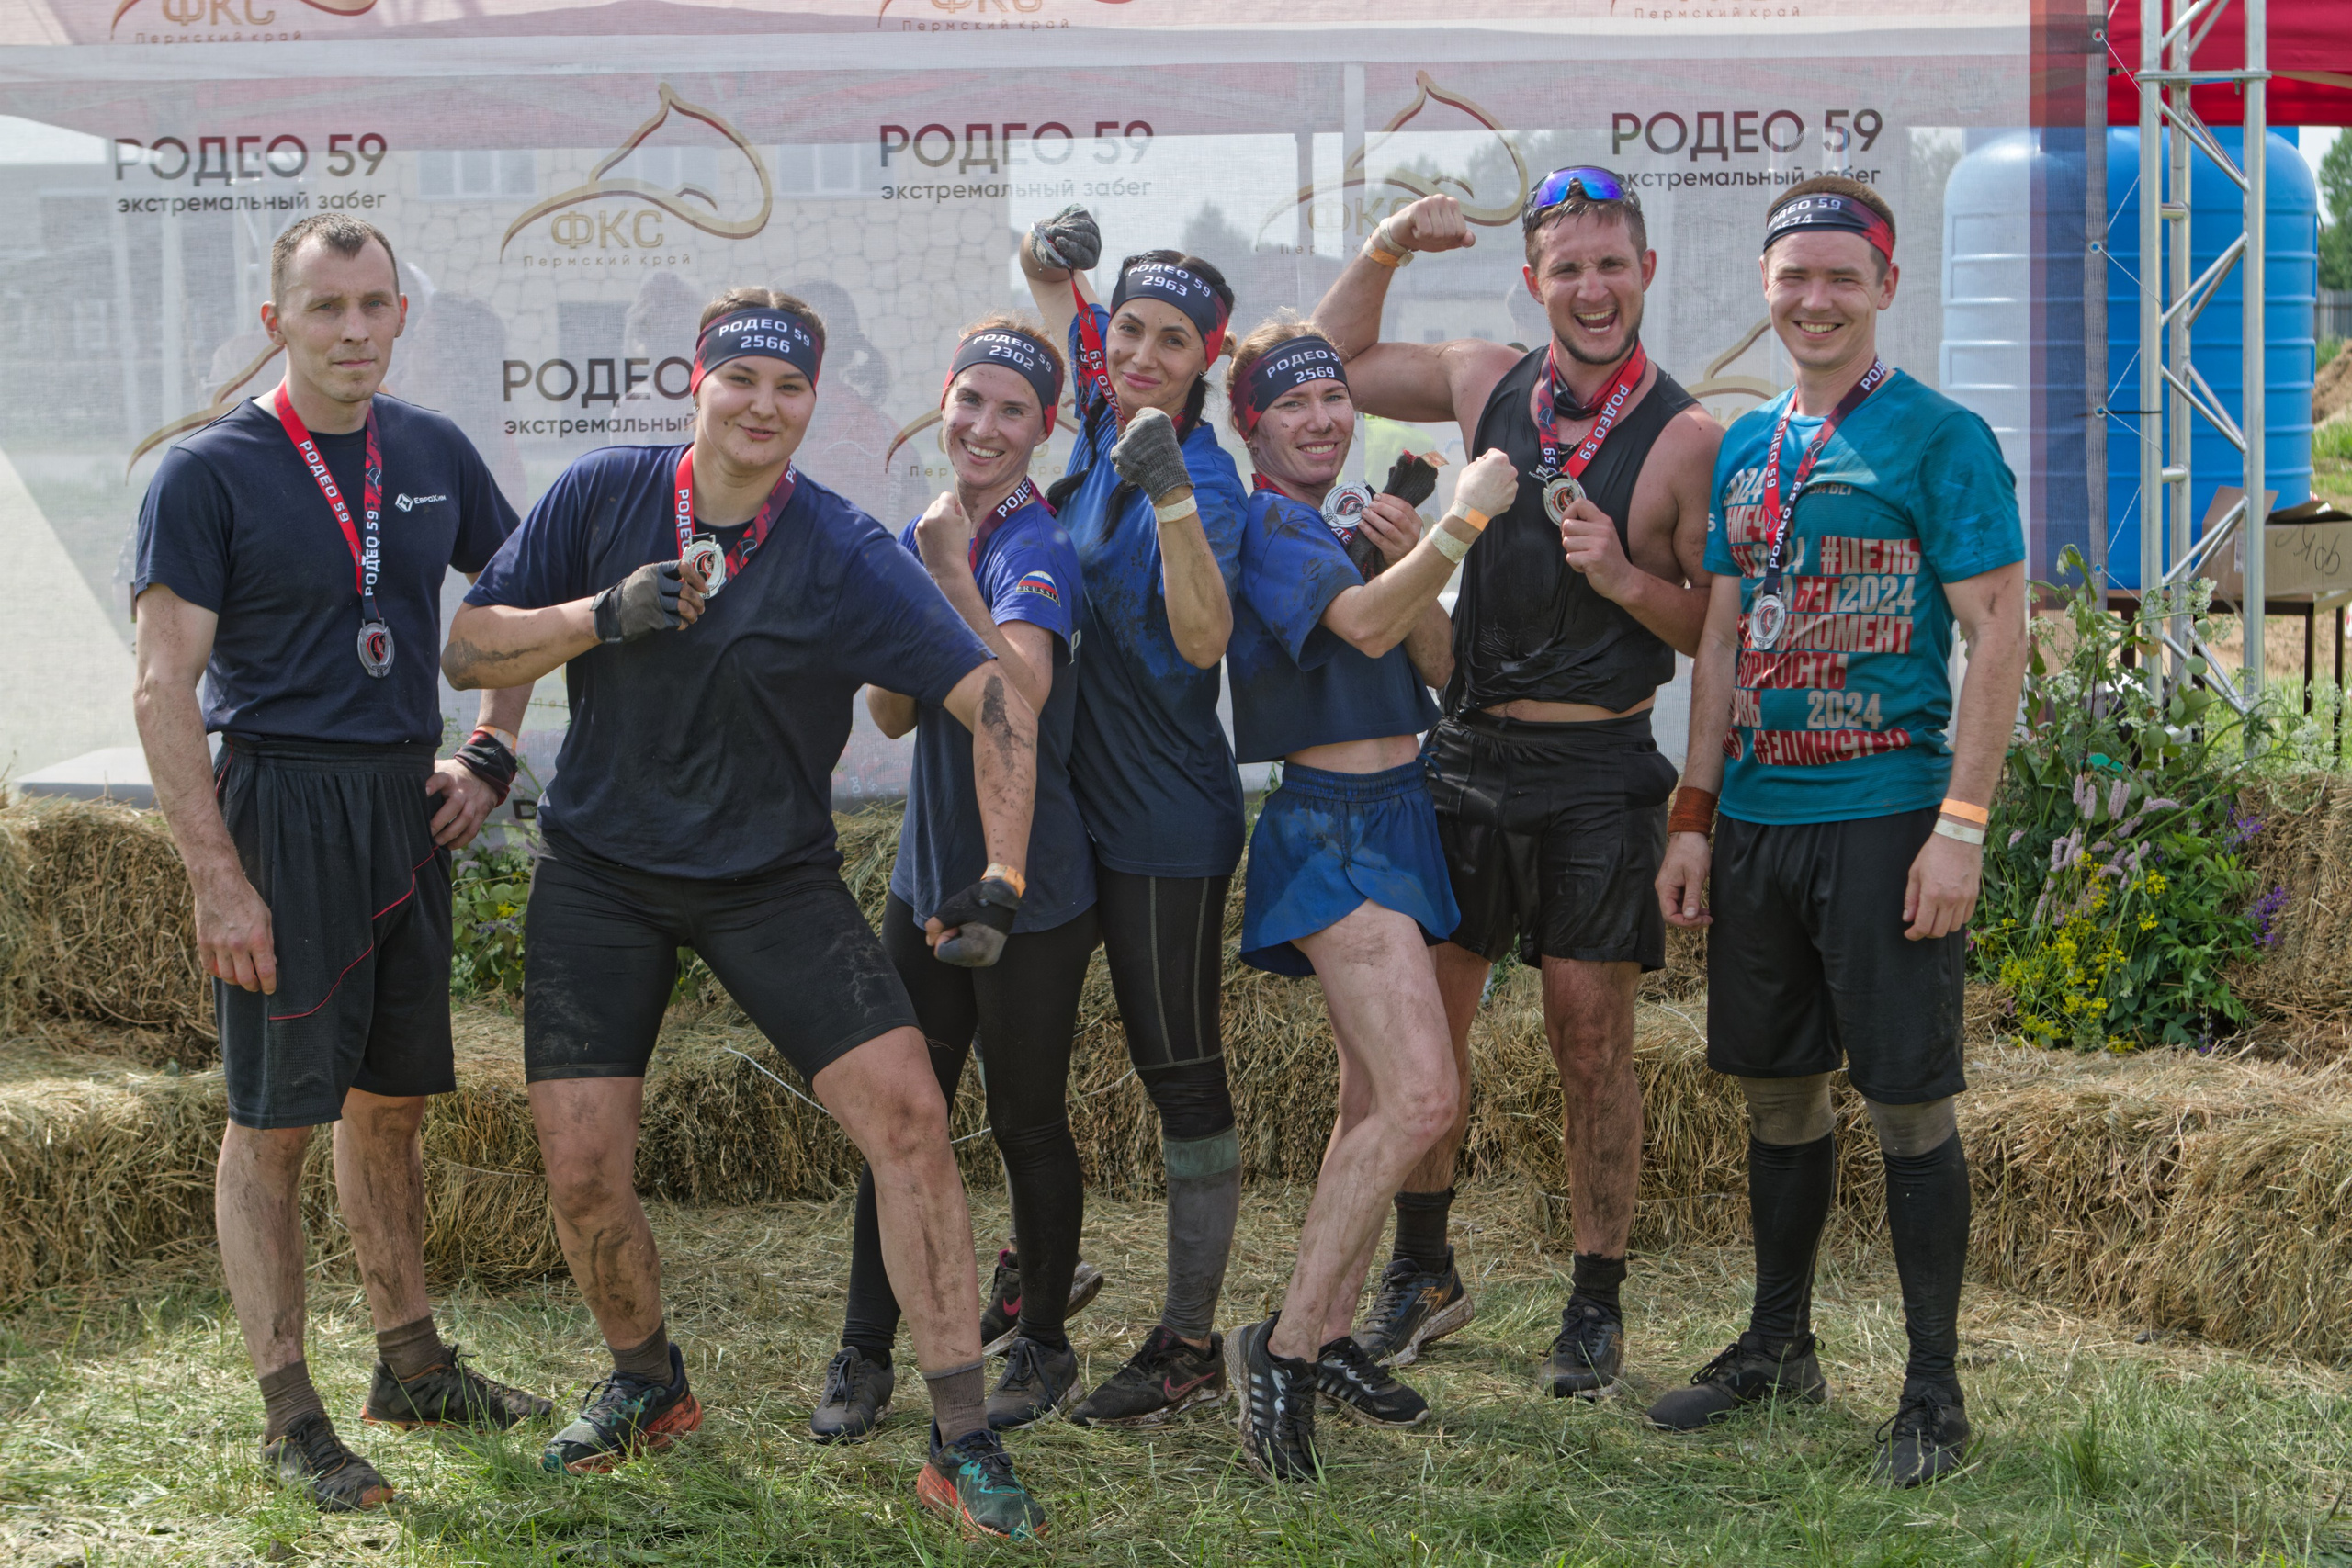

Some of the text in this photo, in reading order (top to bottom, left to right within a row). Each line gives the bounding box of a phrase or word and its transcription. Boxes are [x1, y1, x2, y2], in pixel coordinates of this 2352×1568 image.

[902, 19, 1069, 33] Пермский край
[1634, 7, 1801, 21] Пермский край
[135, 30, 303, 44] Пермский край
[880, 120, 1154, 174] РОДЕО 59
[1612, 108, 1883, 162] РОДЕО 59
[115, 133, 387, 186] РОДЕО 59
[117, 190, 387, 216] экстремальный забег
[881, 177, 1152, 204] экстремальный забег
[1817, 198, 1842, 210] 59
[551, 209, 664, 249] ФКС
[524, 254, 691, 268] Пермский край
[1128, 263, 1211, 298] РОДЕО 59
[1141, 276, 1188, 297] 2963
[718, 318, 810, 347] РОДЕО 59
[741, 334, 790, 354] 2566
[973, 333, 1053, 373] РОДЕО 59
[989, 345, 1035, 371] 2302
[1089, 349, 1103, 370] 59
[1266, 350, 1328, 378] РОДЕО
[503, 356, 695, 409] РОДЕО
[1294, 366, 1336, 384] 2569
[1860, 359, 1887, 391] РОД
[1579, 384, 1630, 460] РОДЕО 59
[1544, 446, 1556, 464] 59
[1766, 413, 1791, 488] РОДЕО 59
[299, 440, 351, 524] РОДЕО 59
[997, 476, 1033, 518] РОДЕ
[1770, 481, 1802, 569] РОДЕО 59
[365, 510, 380, 596] РОДЕО 59
[1820, 536, 1921, 575] #ЦЕЛЬ
[1737, 650, 1849, 690] ОРДОСТЬ
[1807, 691, 1883, 730] 2024
[1753, 727, 1912, 766] #ЕДИНСТВО
